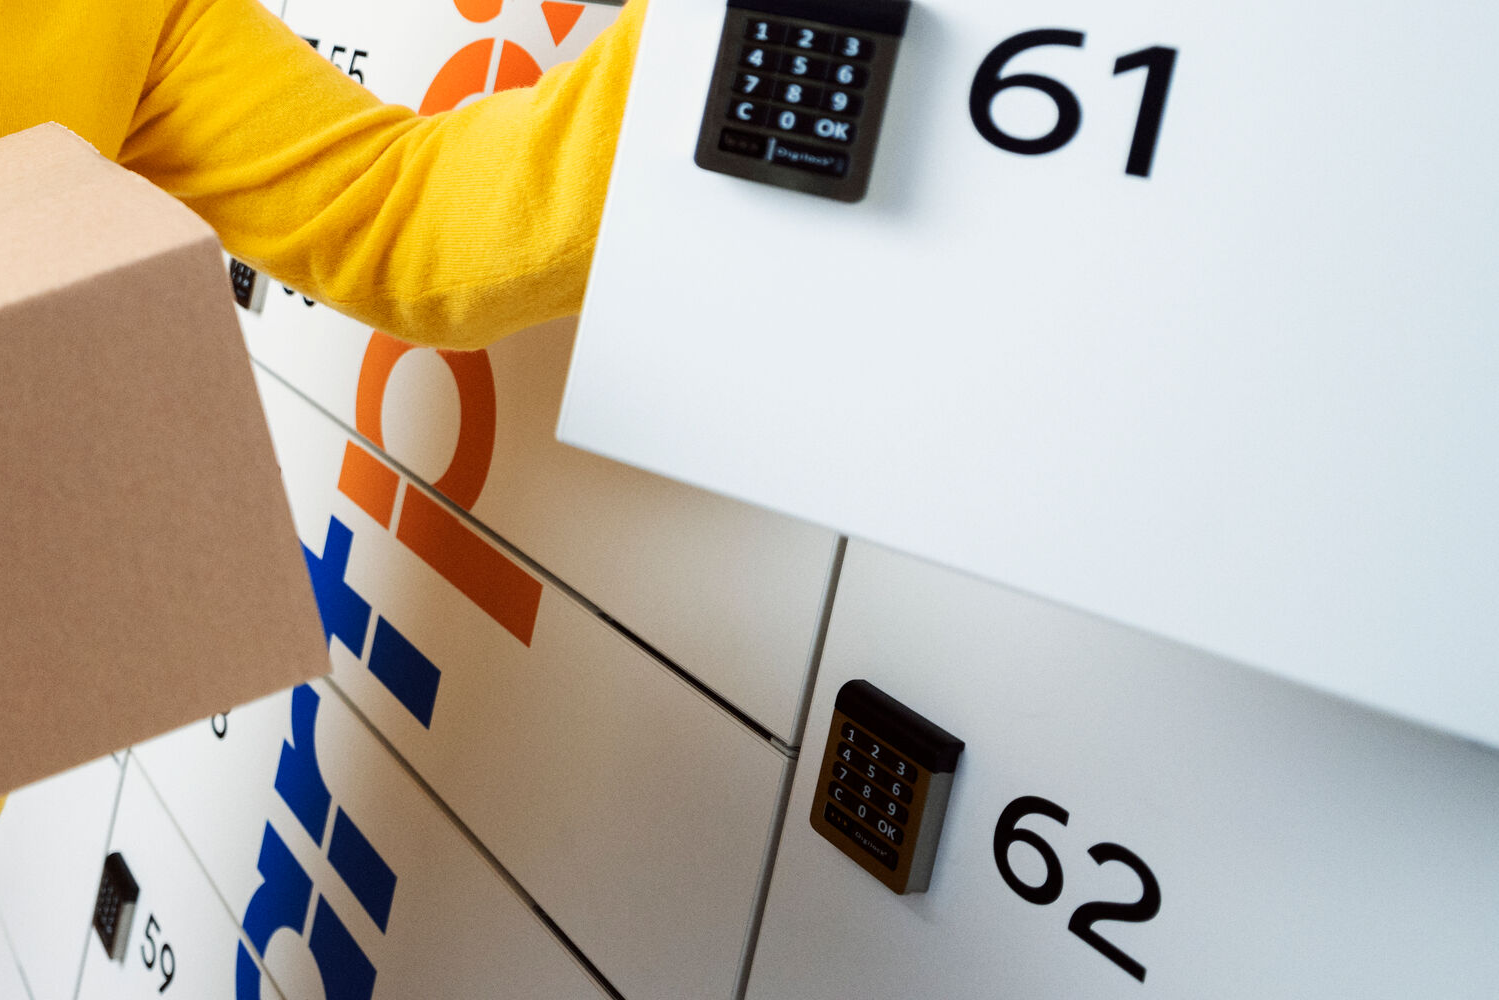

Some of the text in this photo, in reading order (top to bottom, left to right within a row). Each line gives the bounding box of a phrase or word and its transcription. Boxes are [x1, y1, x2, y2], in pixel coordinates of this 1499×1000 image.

[755, 21, 861, 57] 1 2 3
[748, 48, 854, 84] 4 5 6
[744, 74, 849, 112] 7 8 9
[968, 28, 1179, 179] 61
[736, 101, 850, 140] C 0 OK
[842, 748, 901, 797] 4 5 6
[847, 728, 906, 777] 1 2 3
[834, 787, 897, 841] C 0 OK
[839, 767, 897, 817] 7 8 9
[992, 794, 1162, 985] 62
[141, 913, 175, 993] 59
